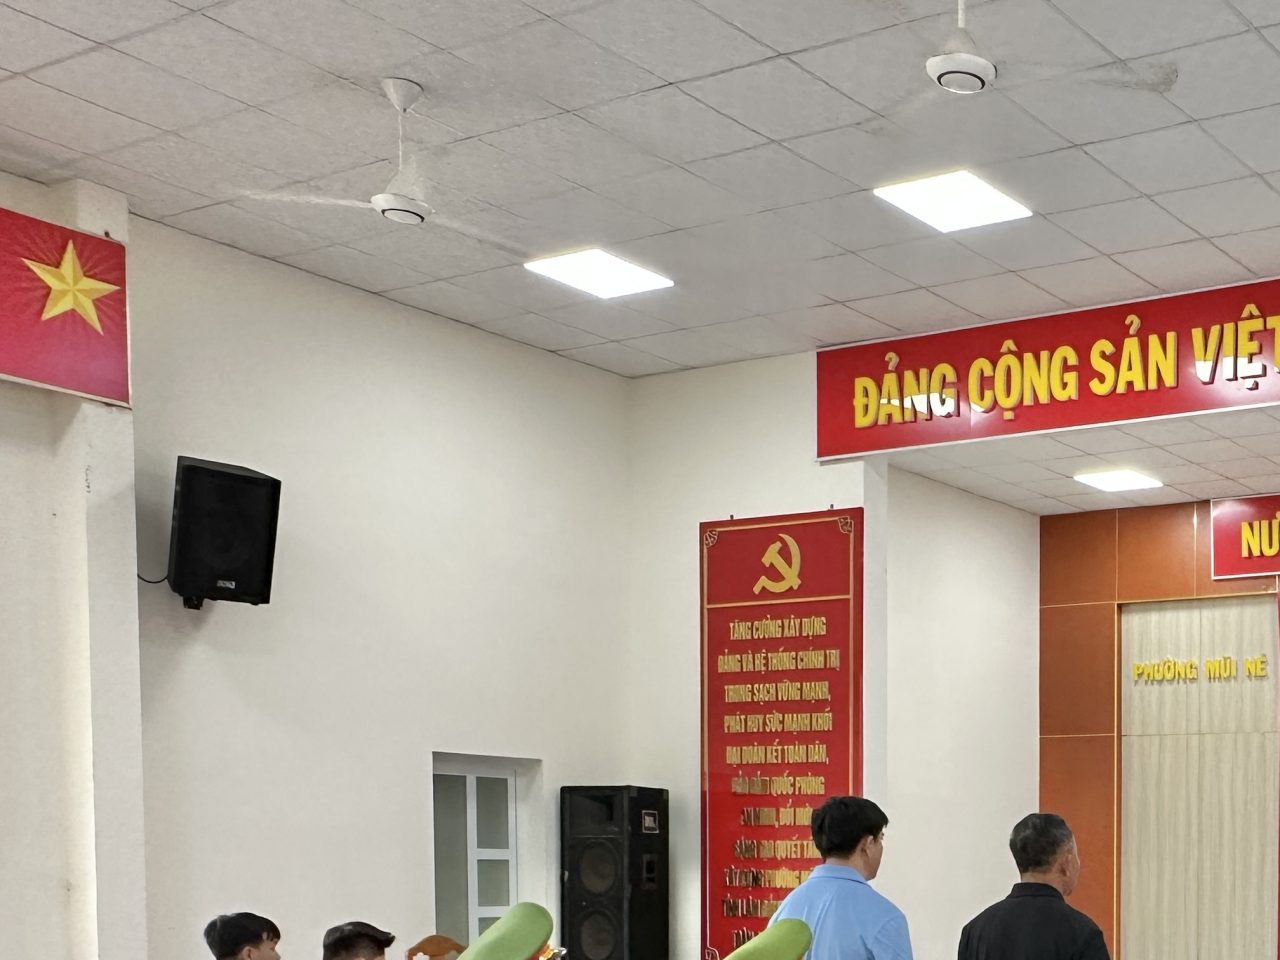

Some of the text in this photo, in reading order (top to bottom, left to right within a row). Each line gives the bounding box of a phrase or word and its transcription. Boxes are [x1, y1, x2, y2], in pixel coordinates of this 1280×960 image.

[853, 352, 956, 429] ĐẢNG
[967, 338, 1079, 419] CỘNG
[1089, 314, 1179, 396] SẢN
[1132, 654, 1269, 682] PHƯỜNG MŨI NÉ
